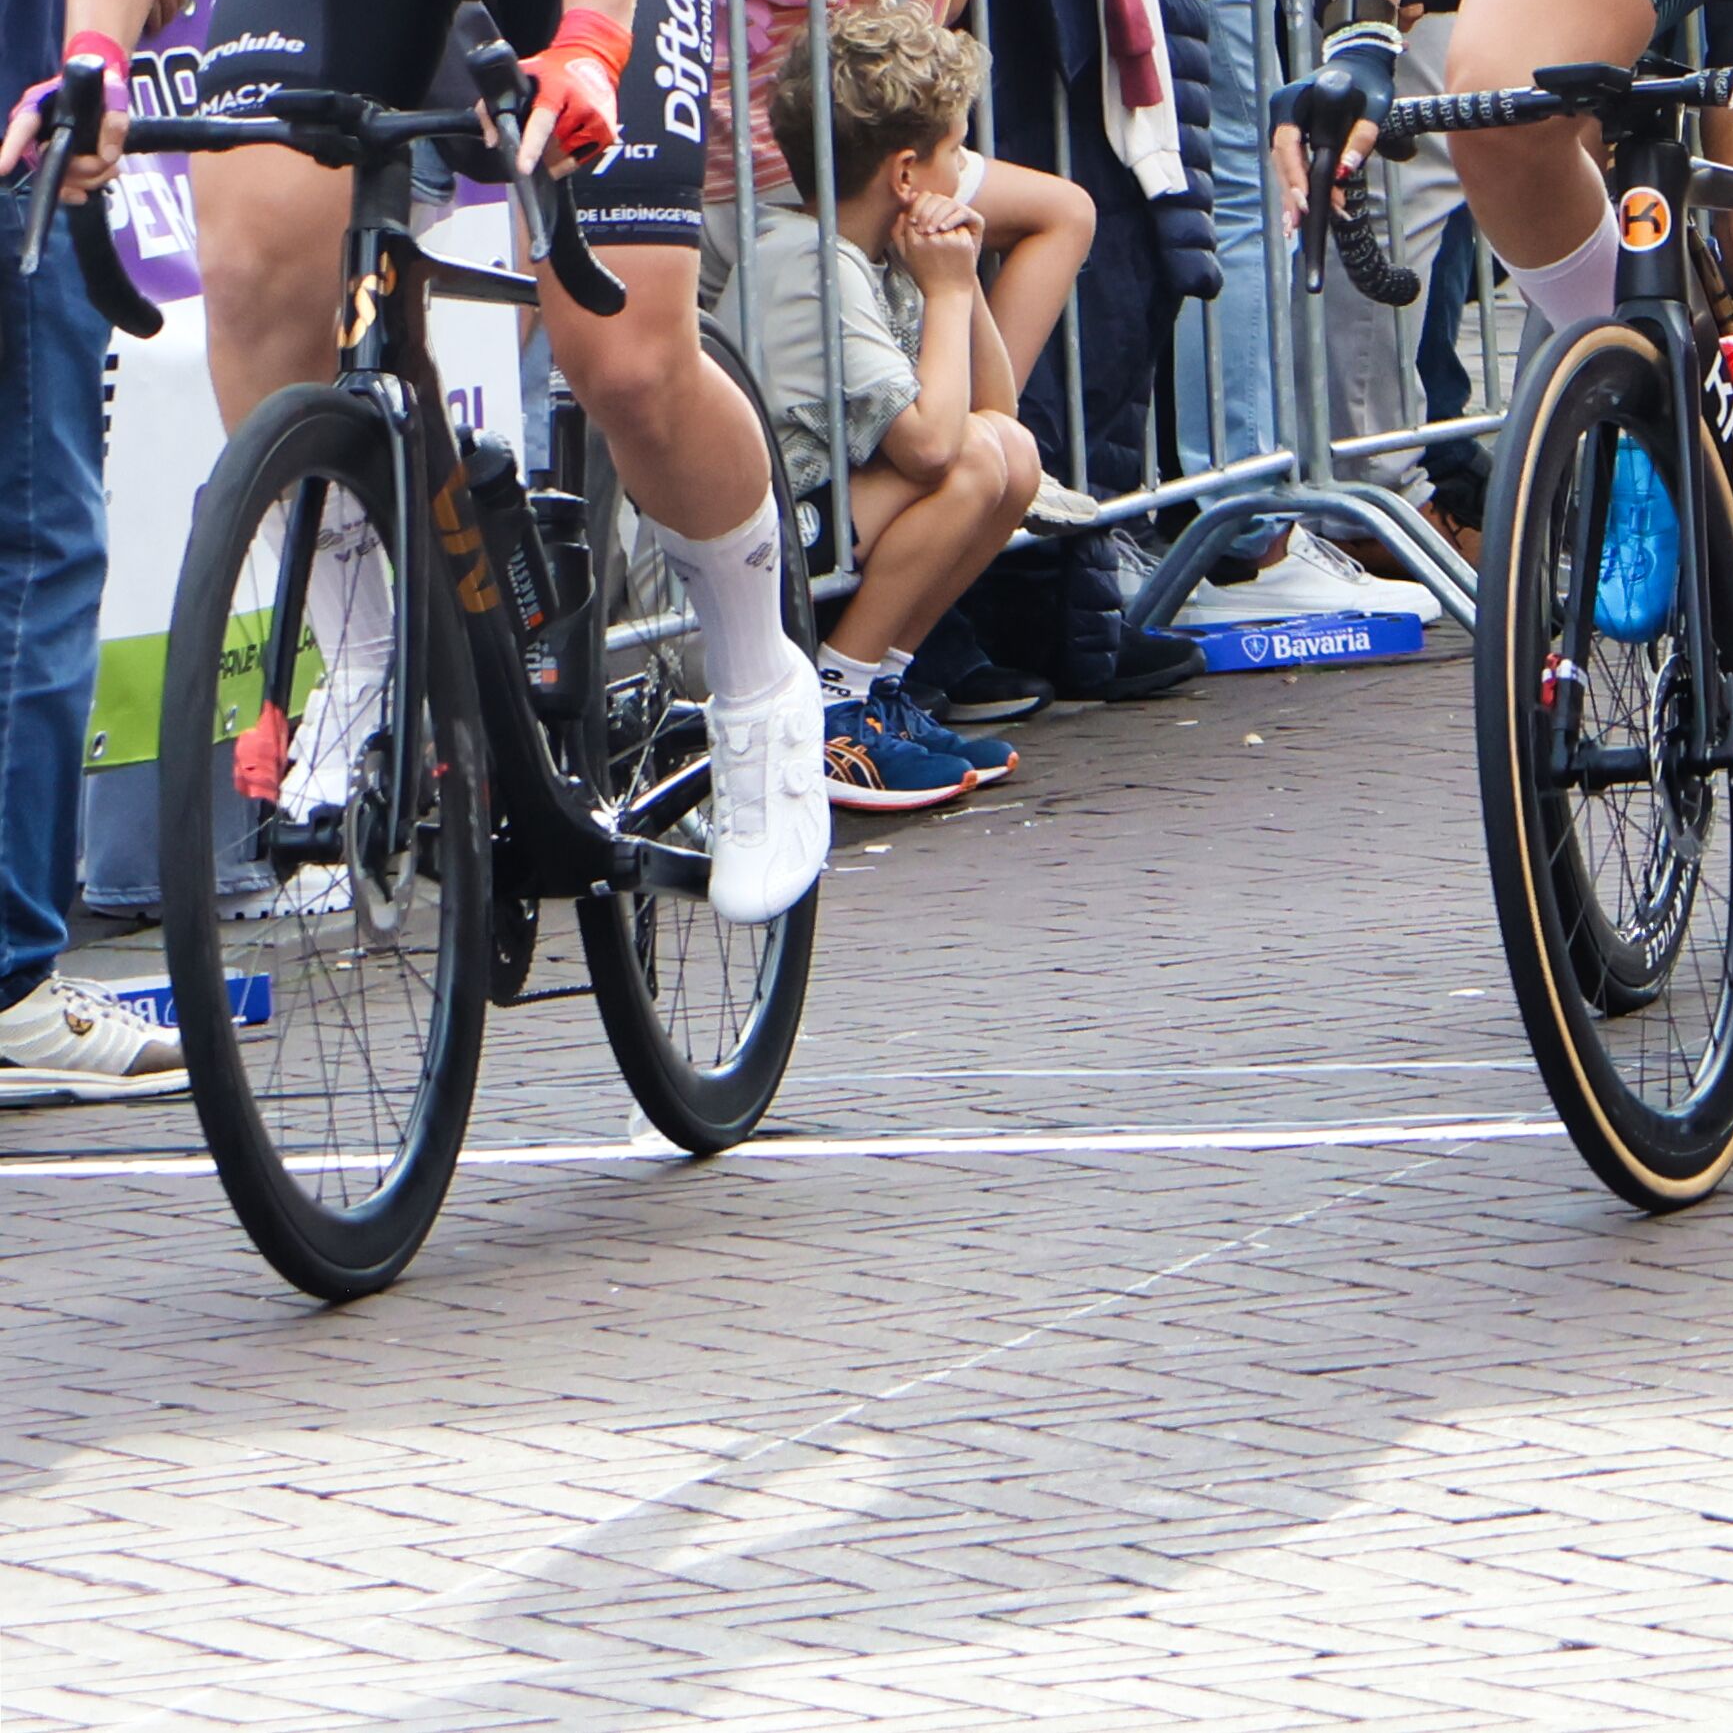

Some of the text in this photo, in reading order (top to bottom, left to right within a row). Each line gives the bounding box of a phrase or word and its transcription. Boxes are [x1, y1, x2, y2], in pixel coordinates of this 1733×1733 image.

[624, 143, 658, 159] ICT
[576, 208, 598, 223] DE
[1272, 627, 1371, 660] Bavaria
